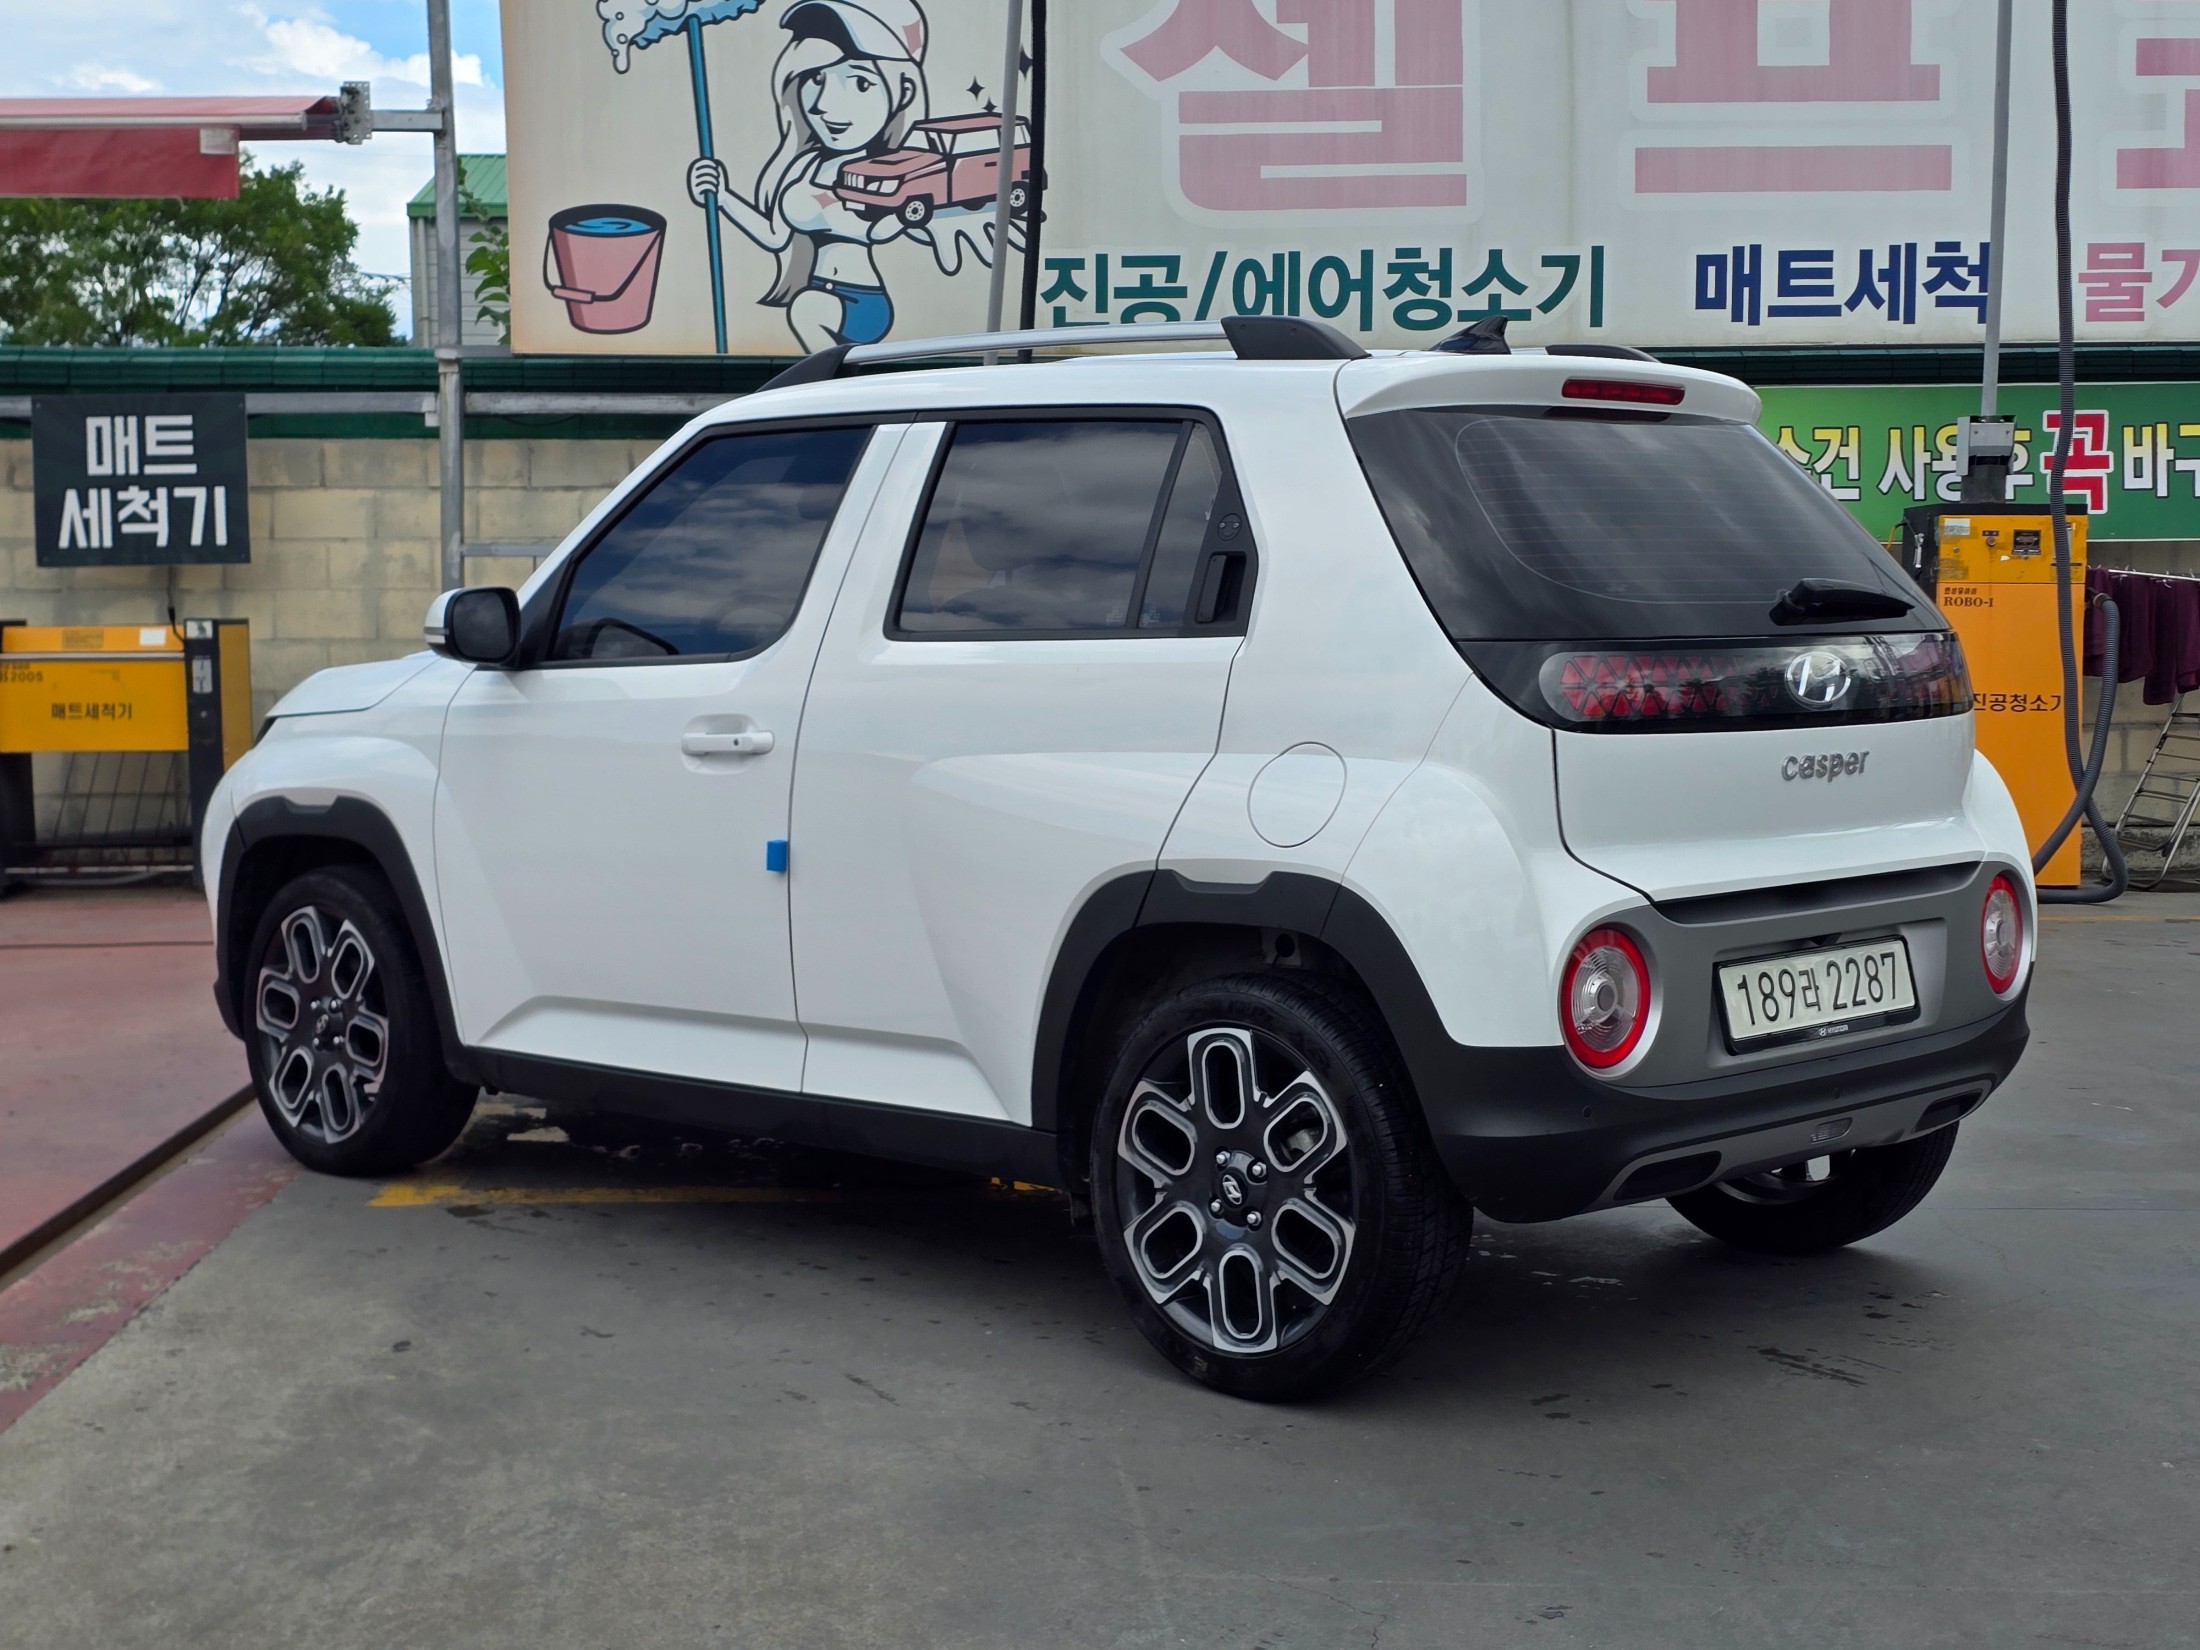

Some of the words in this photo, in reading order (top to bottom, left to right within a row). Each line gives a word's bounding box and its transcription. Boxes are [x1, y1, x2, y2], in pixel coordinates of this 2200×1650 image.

[1040, 246, 1604, 331] 진공/에어청소기
[1695, 242, 1990, 326] 매트세척
[86, 415, 197, 476] 매트
[2040, 410, 2114, 514] 꼭
[58, 485, 228, 549] 세척기
[51, 703, 133, 720] 매트세척기
